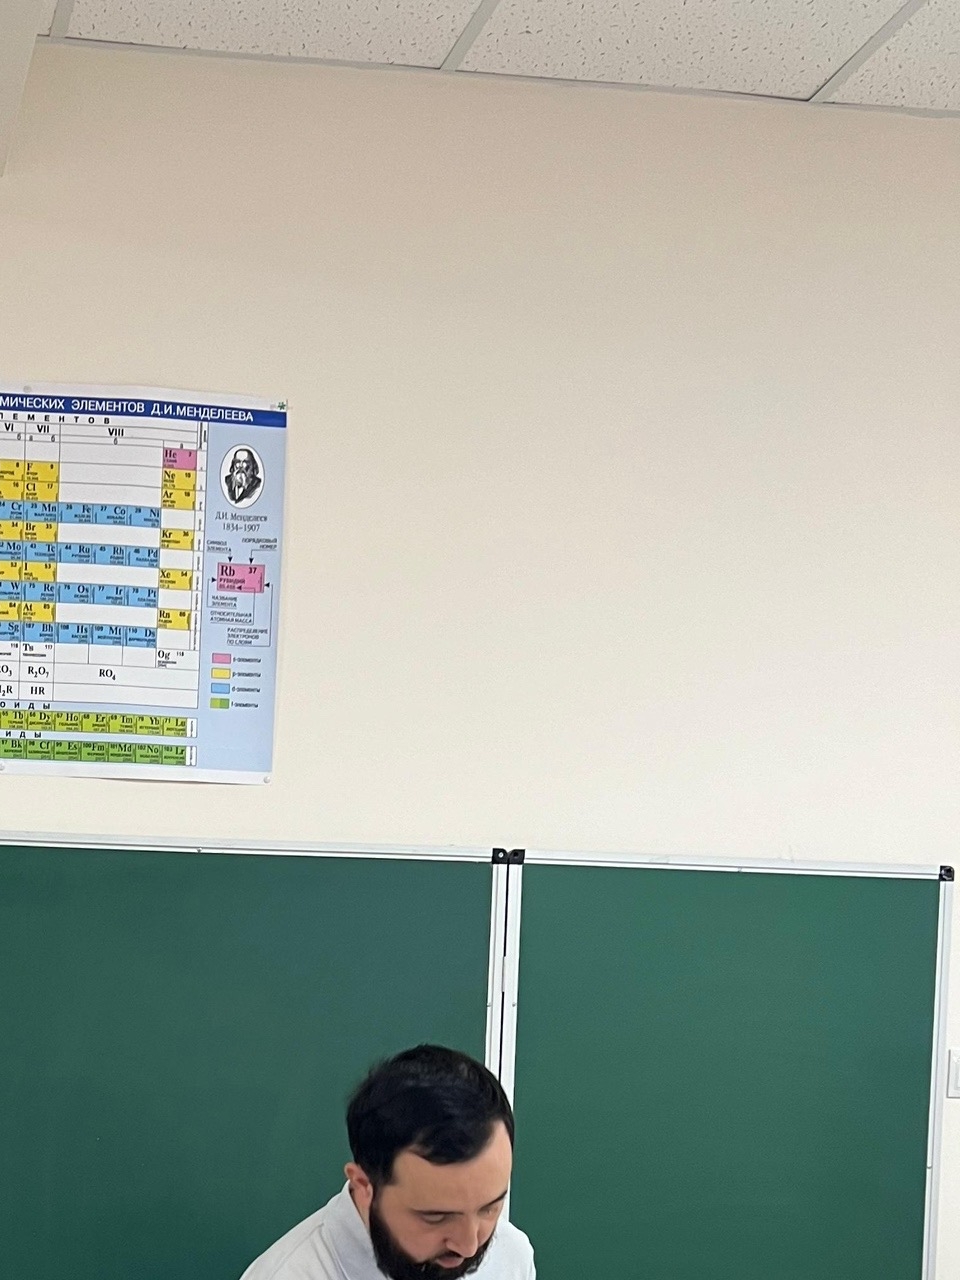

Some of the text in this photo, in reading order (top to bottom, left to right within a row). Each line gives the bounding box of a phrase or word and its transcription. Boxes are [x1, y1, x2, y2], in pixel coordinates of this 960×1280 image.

[72, 400, 145, 413] ЭЛЕМЕНТОВ
[151, 402, 254, 422] Д.И.МЕНДЕЛЕЕВА
[165, 450, 176, 459] He
[164, 470, 175, 479] Ne
[26, 483, 36, 491] Cl
[163, 490, 173, 498] Ar
[12, 502, 22, 510] Cr
[42, 504, 56, 512] Mn
[114, 507, 125, 515] Co
[230, 512, 267, 521] Менделеев
[26, 523, 36, 531] Br
[162, 530, 172, 538] Kr
[7, 542, 21, 550] Mo
[160, 570, 170, 578] Xe
[220, 565, 235, 576] Rb
[77, 585, 89, 593] Os
[158, 650, 170, 660] Og
[31, 686, 45, 695] HR
